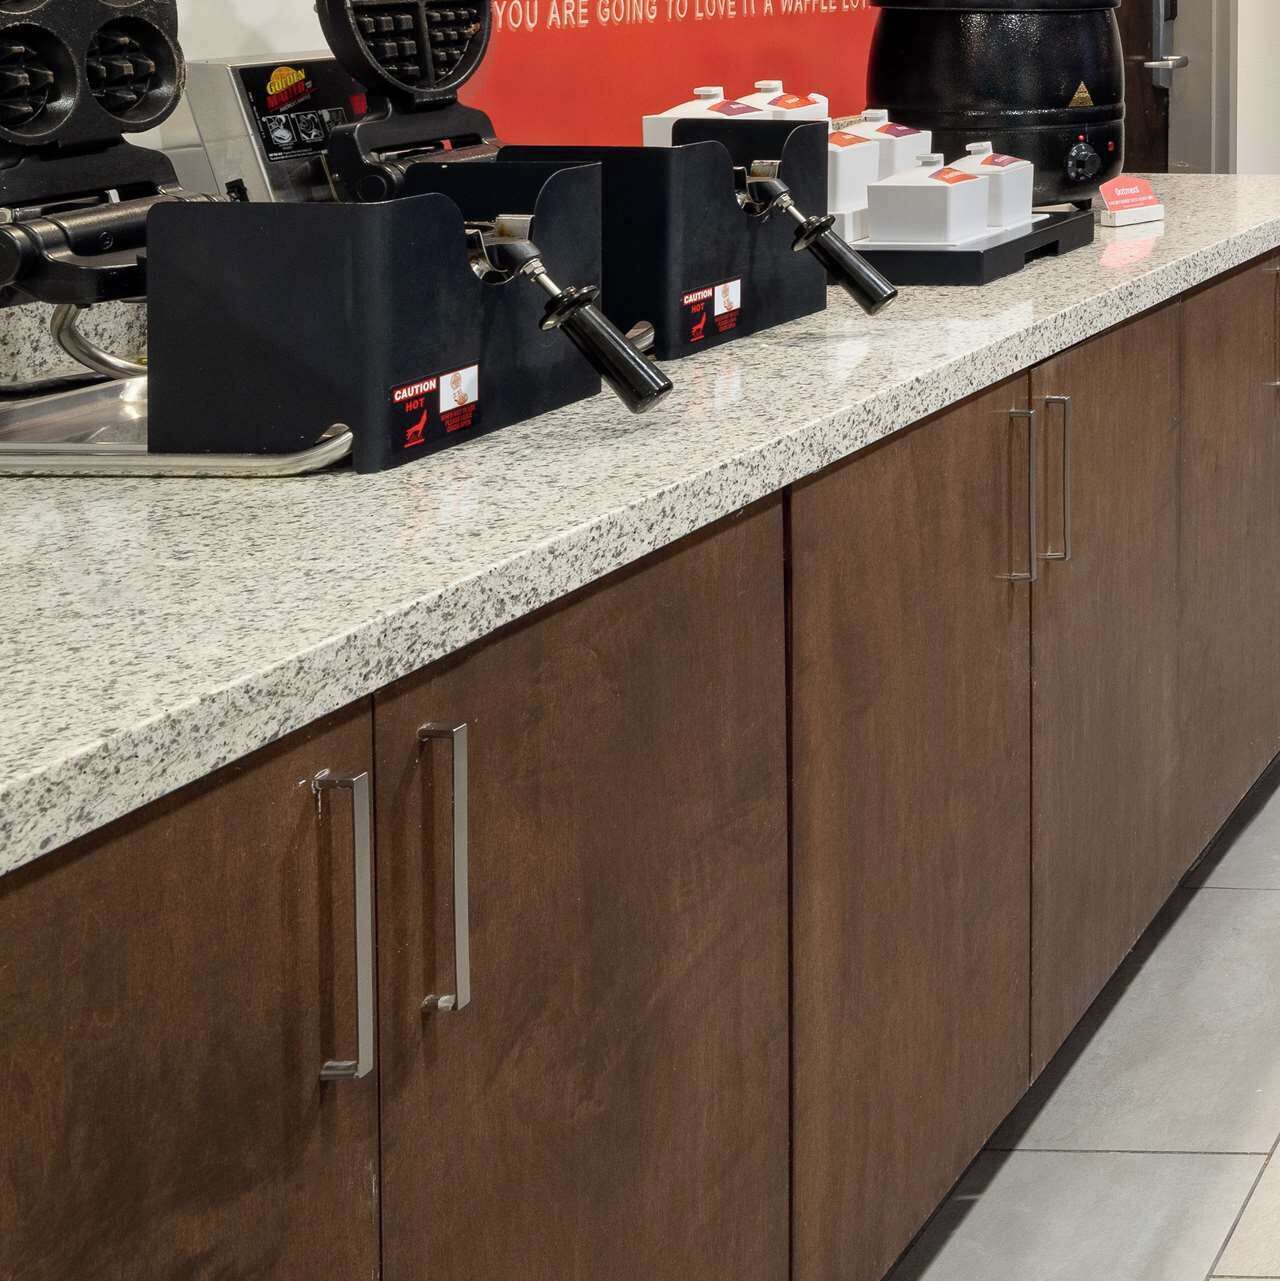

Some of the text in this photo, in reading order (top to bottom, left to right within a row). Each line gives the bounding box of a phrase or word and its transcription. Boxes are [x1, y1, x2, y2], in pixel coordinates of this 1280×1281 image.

[491, 0, 540, 32] YOU
[683, 287, 713, 305] CAUTION
[691, 303, 705, 313] HOT
[394, 378, 438, 401] CAUTION
[404, 397, 425, 412] HOT
